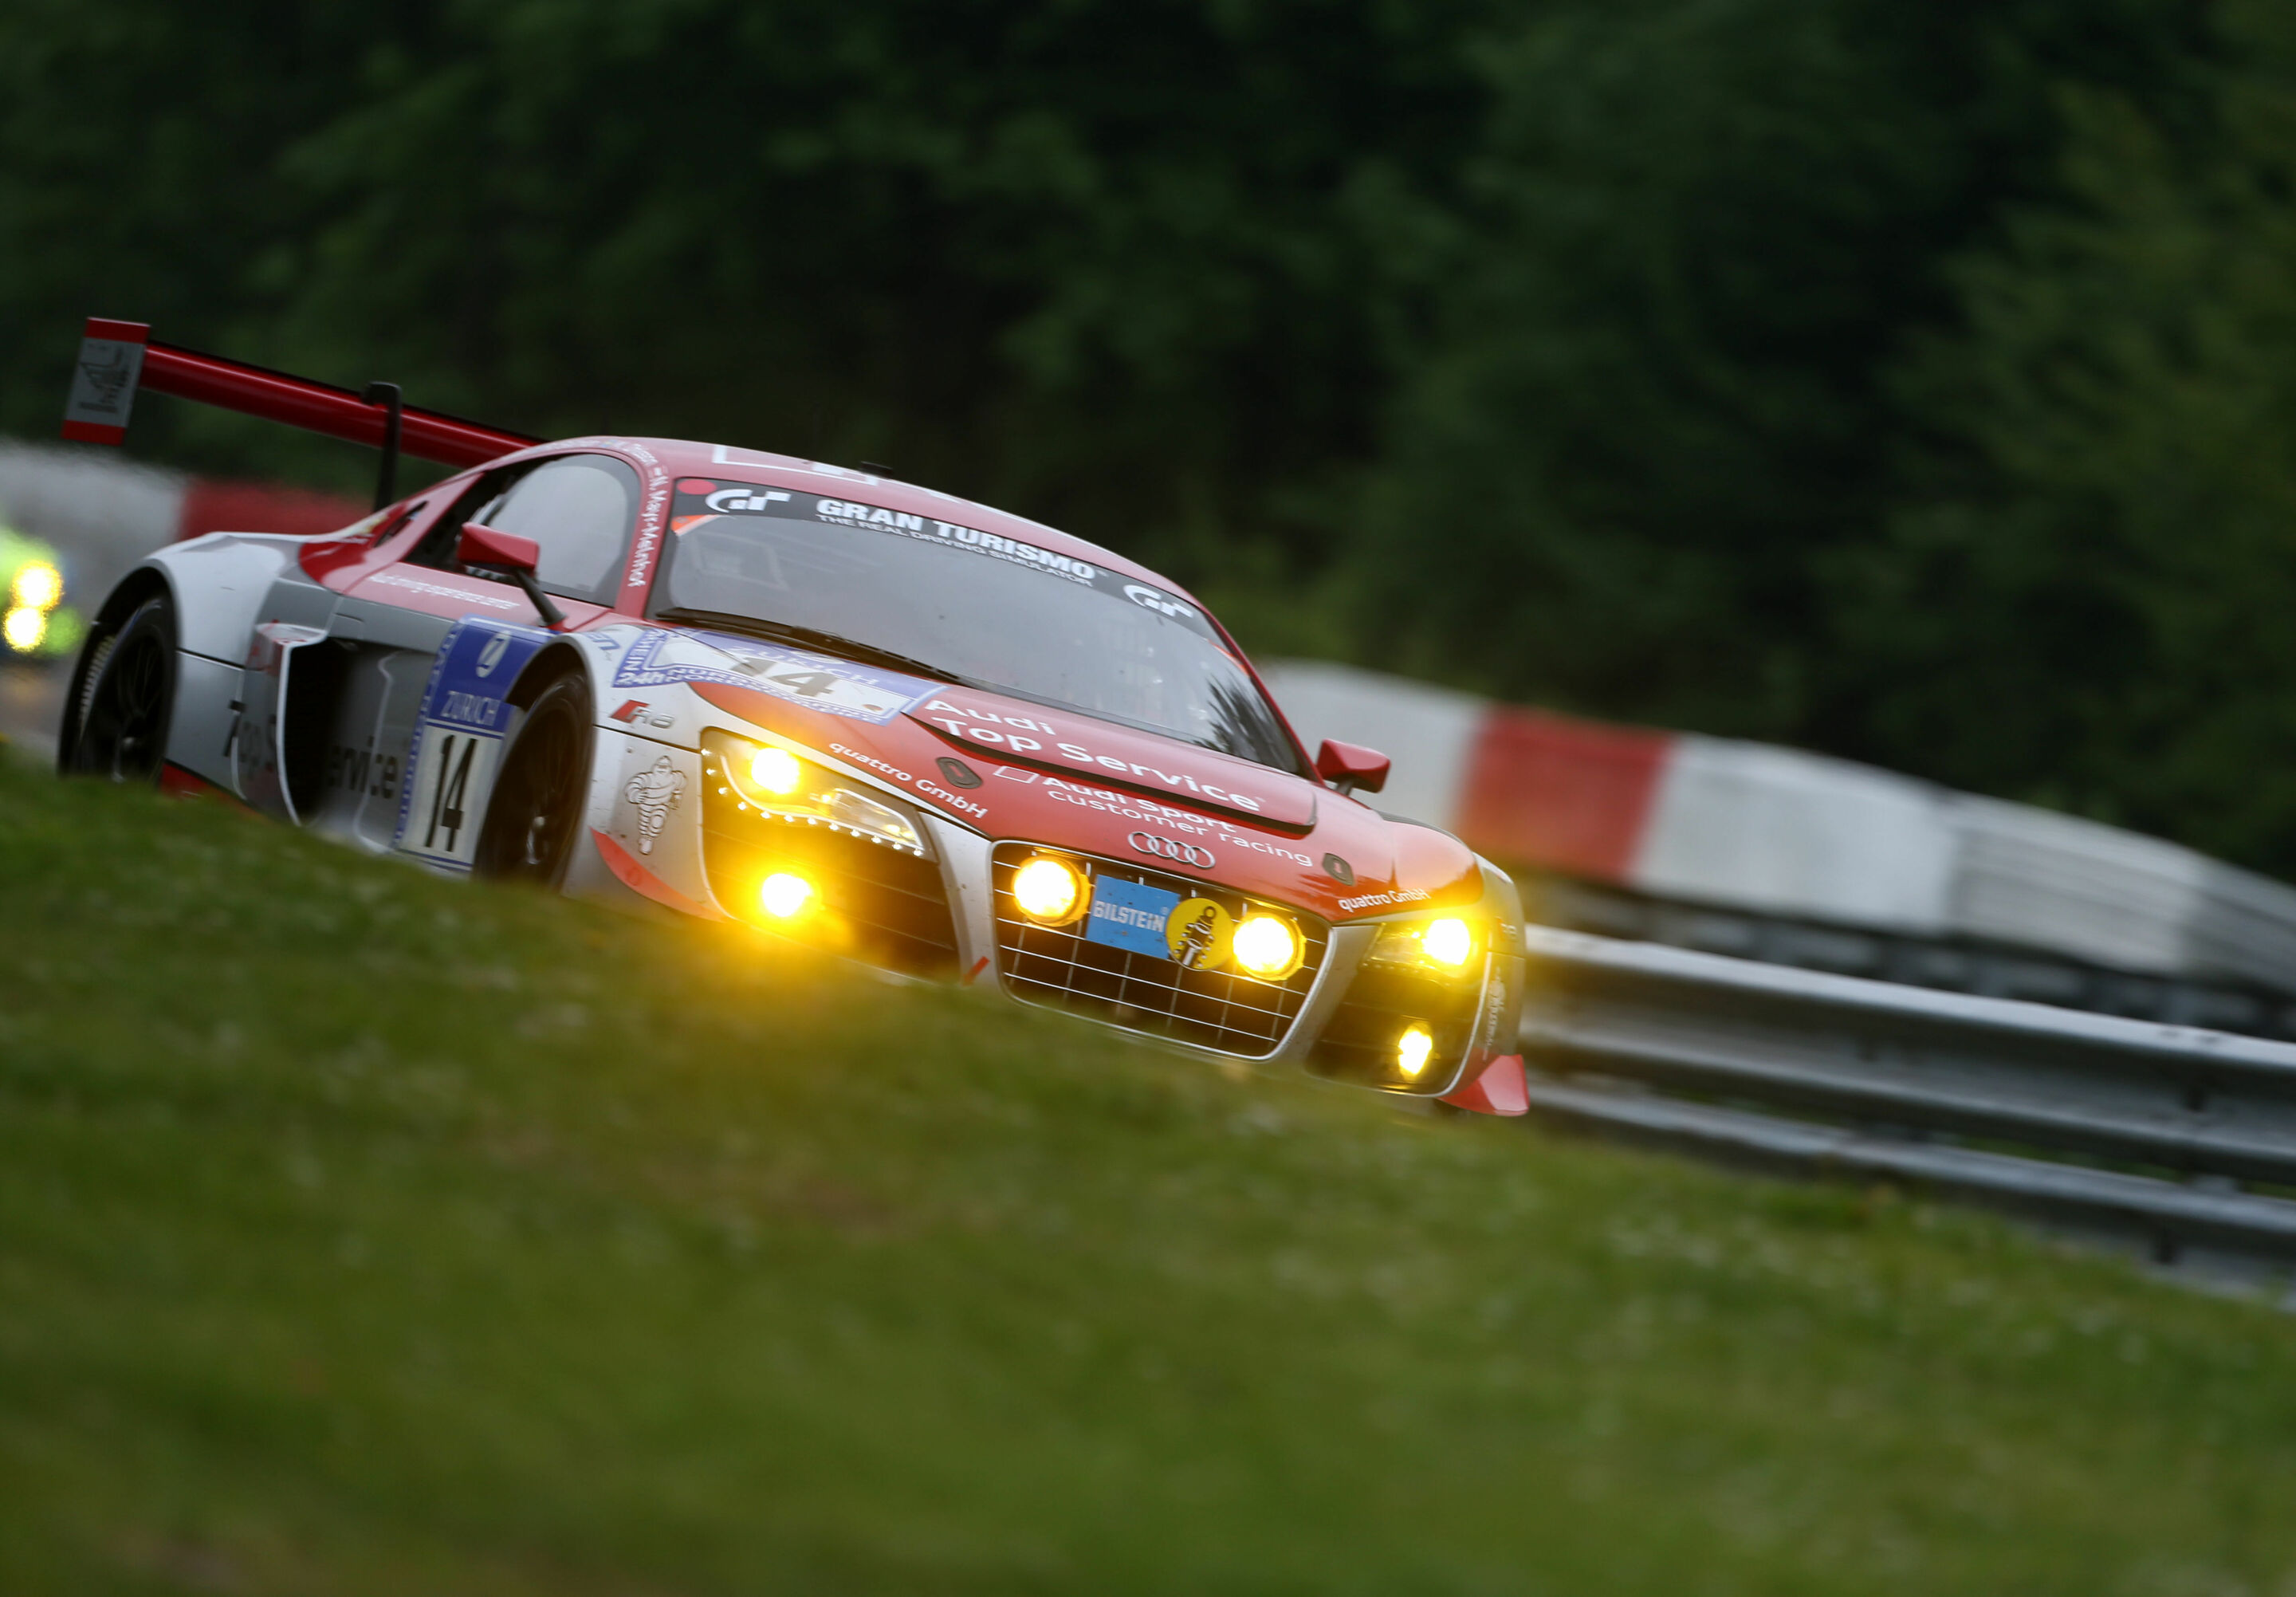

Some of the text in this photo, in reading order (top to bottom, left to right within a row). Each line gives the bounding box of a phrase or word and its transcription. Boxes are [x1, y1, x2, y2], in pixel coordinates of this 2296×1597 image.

[815, 513, 1094, 588] THE REAL DRIVING SIMULATOR
[816, 499, 1095, 579] GRAN TURISMO
[729, 656, 838, 697] 14
[925, 700, 1056, 735] Audi
[424, 734, 478, 852] 14
[828, 742, 989, 819] quattro GmbH
[931, 717, 1261, 812] Top Service
[1042, 777, 1238, 834] Audi Sport
[1048, 790, 1314, 867] customer racing
[1093, 900, 1166, 933] BILSTEIN
[1338, 888, 1431, 912] quattro GmbH
